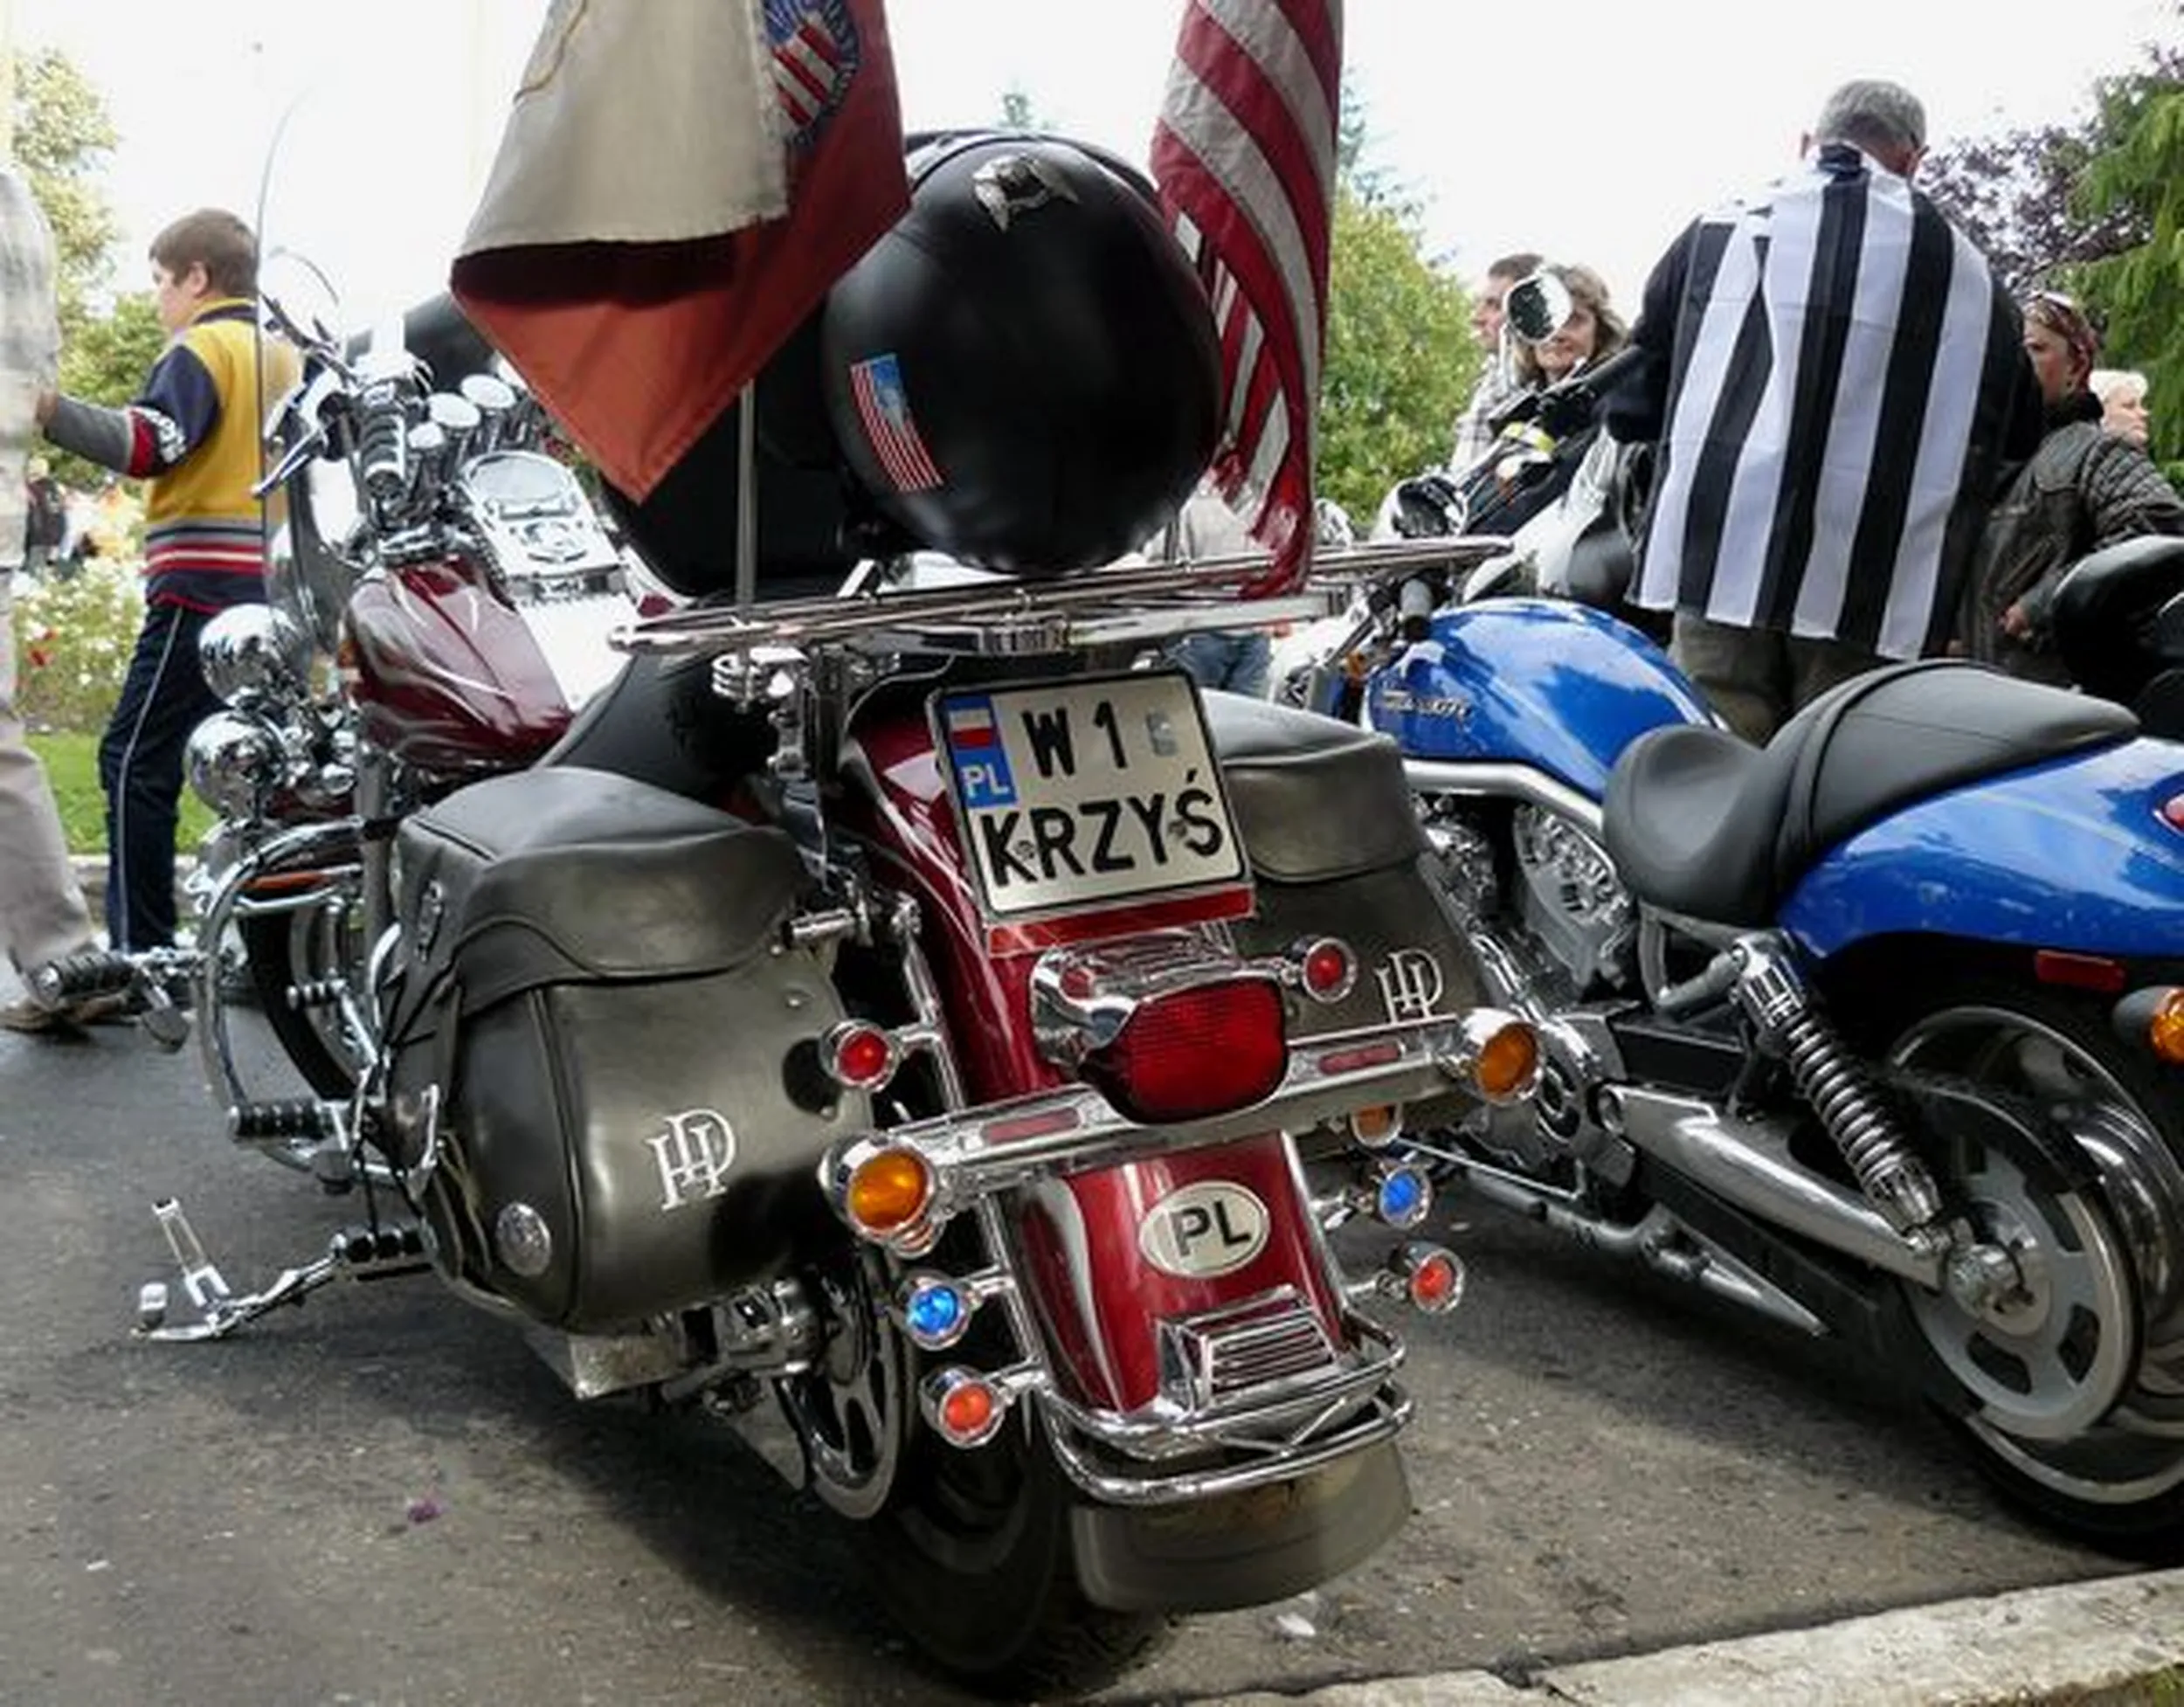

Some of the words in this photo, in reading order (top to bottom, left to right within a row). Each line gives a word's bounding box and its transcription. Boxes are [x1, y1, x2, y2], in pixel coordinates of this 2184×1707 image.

[962, 763, 1009, 798] PL
[979, 768, 1223, 887] KRZYŚ
[1171, 1199, 1252, 1257] PL
